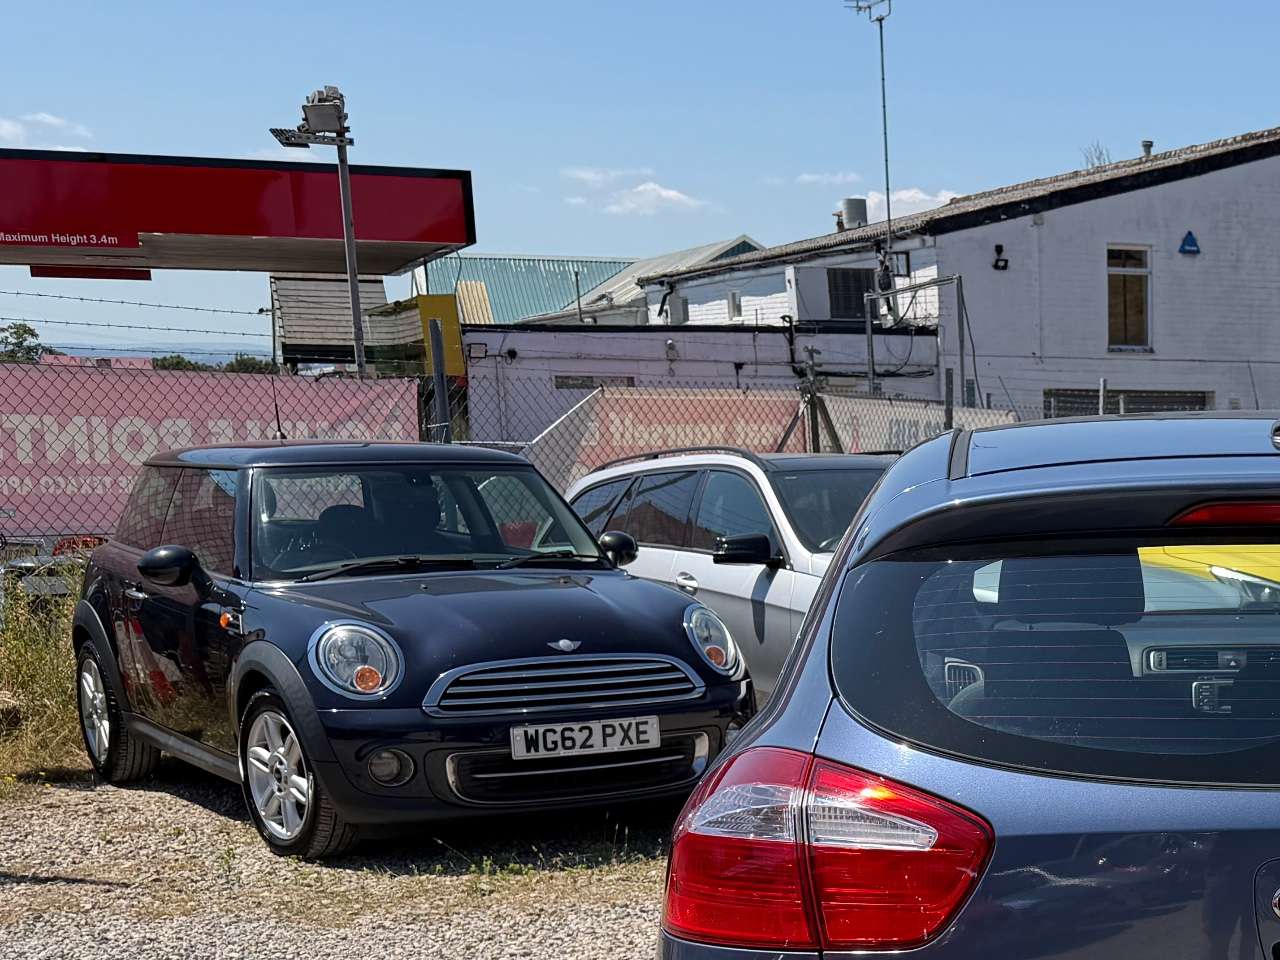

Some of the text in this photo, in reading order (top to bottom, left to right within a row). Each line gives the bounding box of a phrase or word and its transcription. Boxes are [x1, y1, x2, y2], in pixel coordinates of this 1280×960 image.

[52, 233, 87, 245] Height
[89, 234, 118, 245] 3.4m
[524, 721, 650, 754] WG62 PXE
